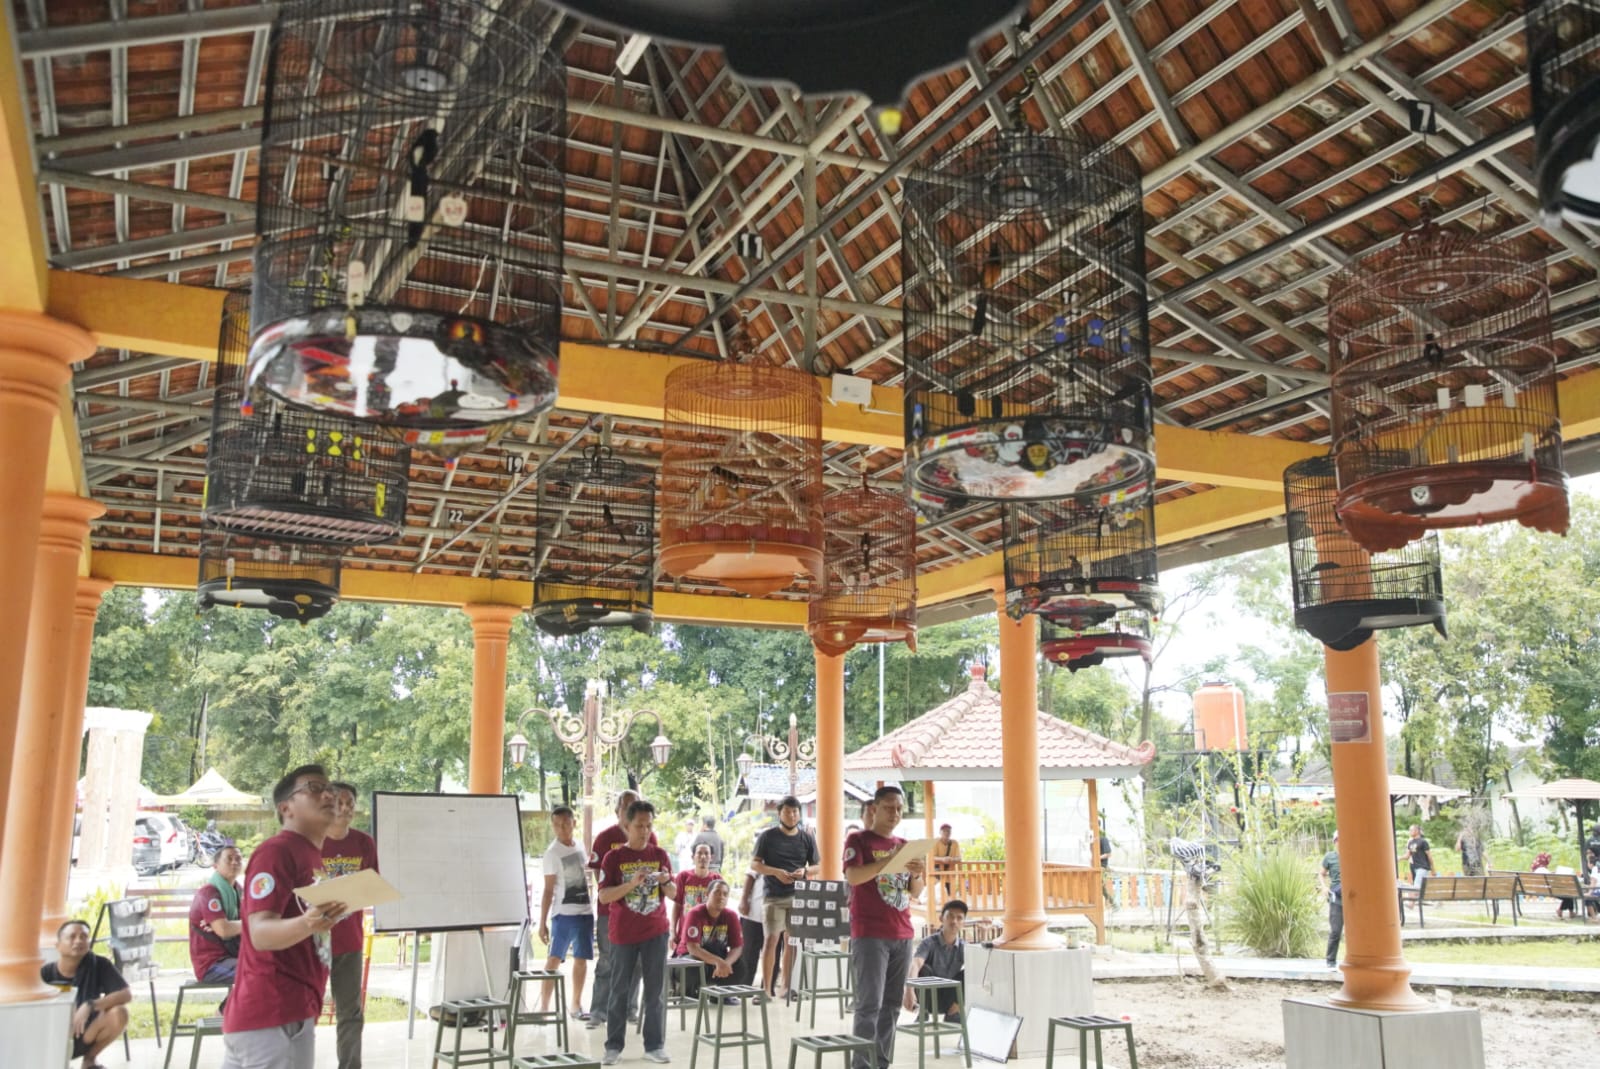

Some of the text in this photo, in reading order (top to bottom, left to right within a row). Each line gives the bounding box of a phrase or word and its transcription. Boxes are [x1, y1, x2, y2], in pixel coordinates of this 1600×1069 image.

[1417, 102, 1431, 132] 7
[741, 233, 762, 260] 11
[508, 456, 523, 473] 19
[449, 510, 463, 523] 22
[634, 520, 648, 535] 23
